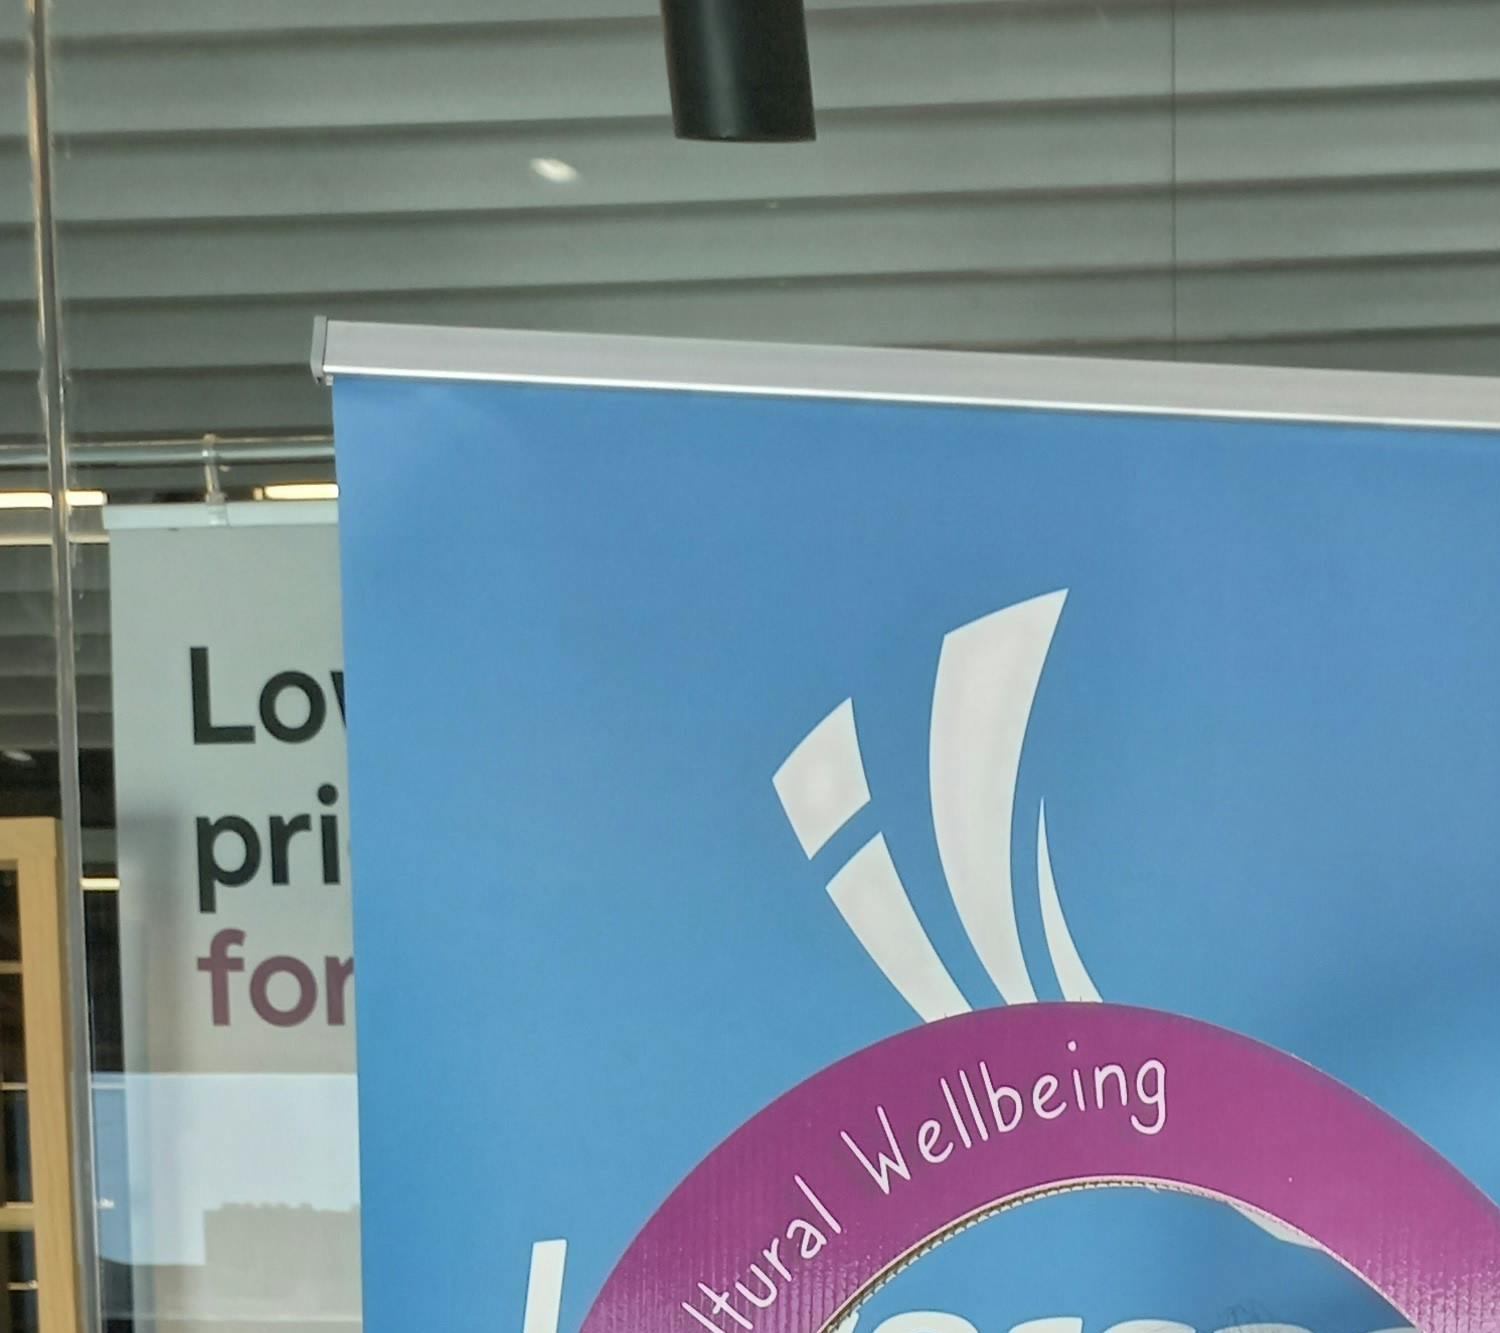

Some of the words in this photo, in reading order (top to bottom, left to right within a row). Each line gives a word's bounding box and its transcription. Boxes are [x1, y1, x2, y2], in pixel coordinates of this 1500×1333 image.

[190, 646, 346, 744] Lo
[196, 783, 342, 914] pri
[197, 928, 354, 1027] for
[841, 1041, 1167, 1196] Wellbeing
